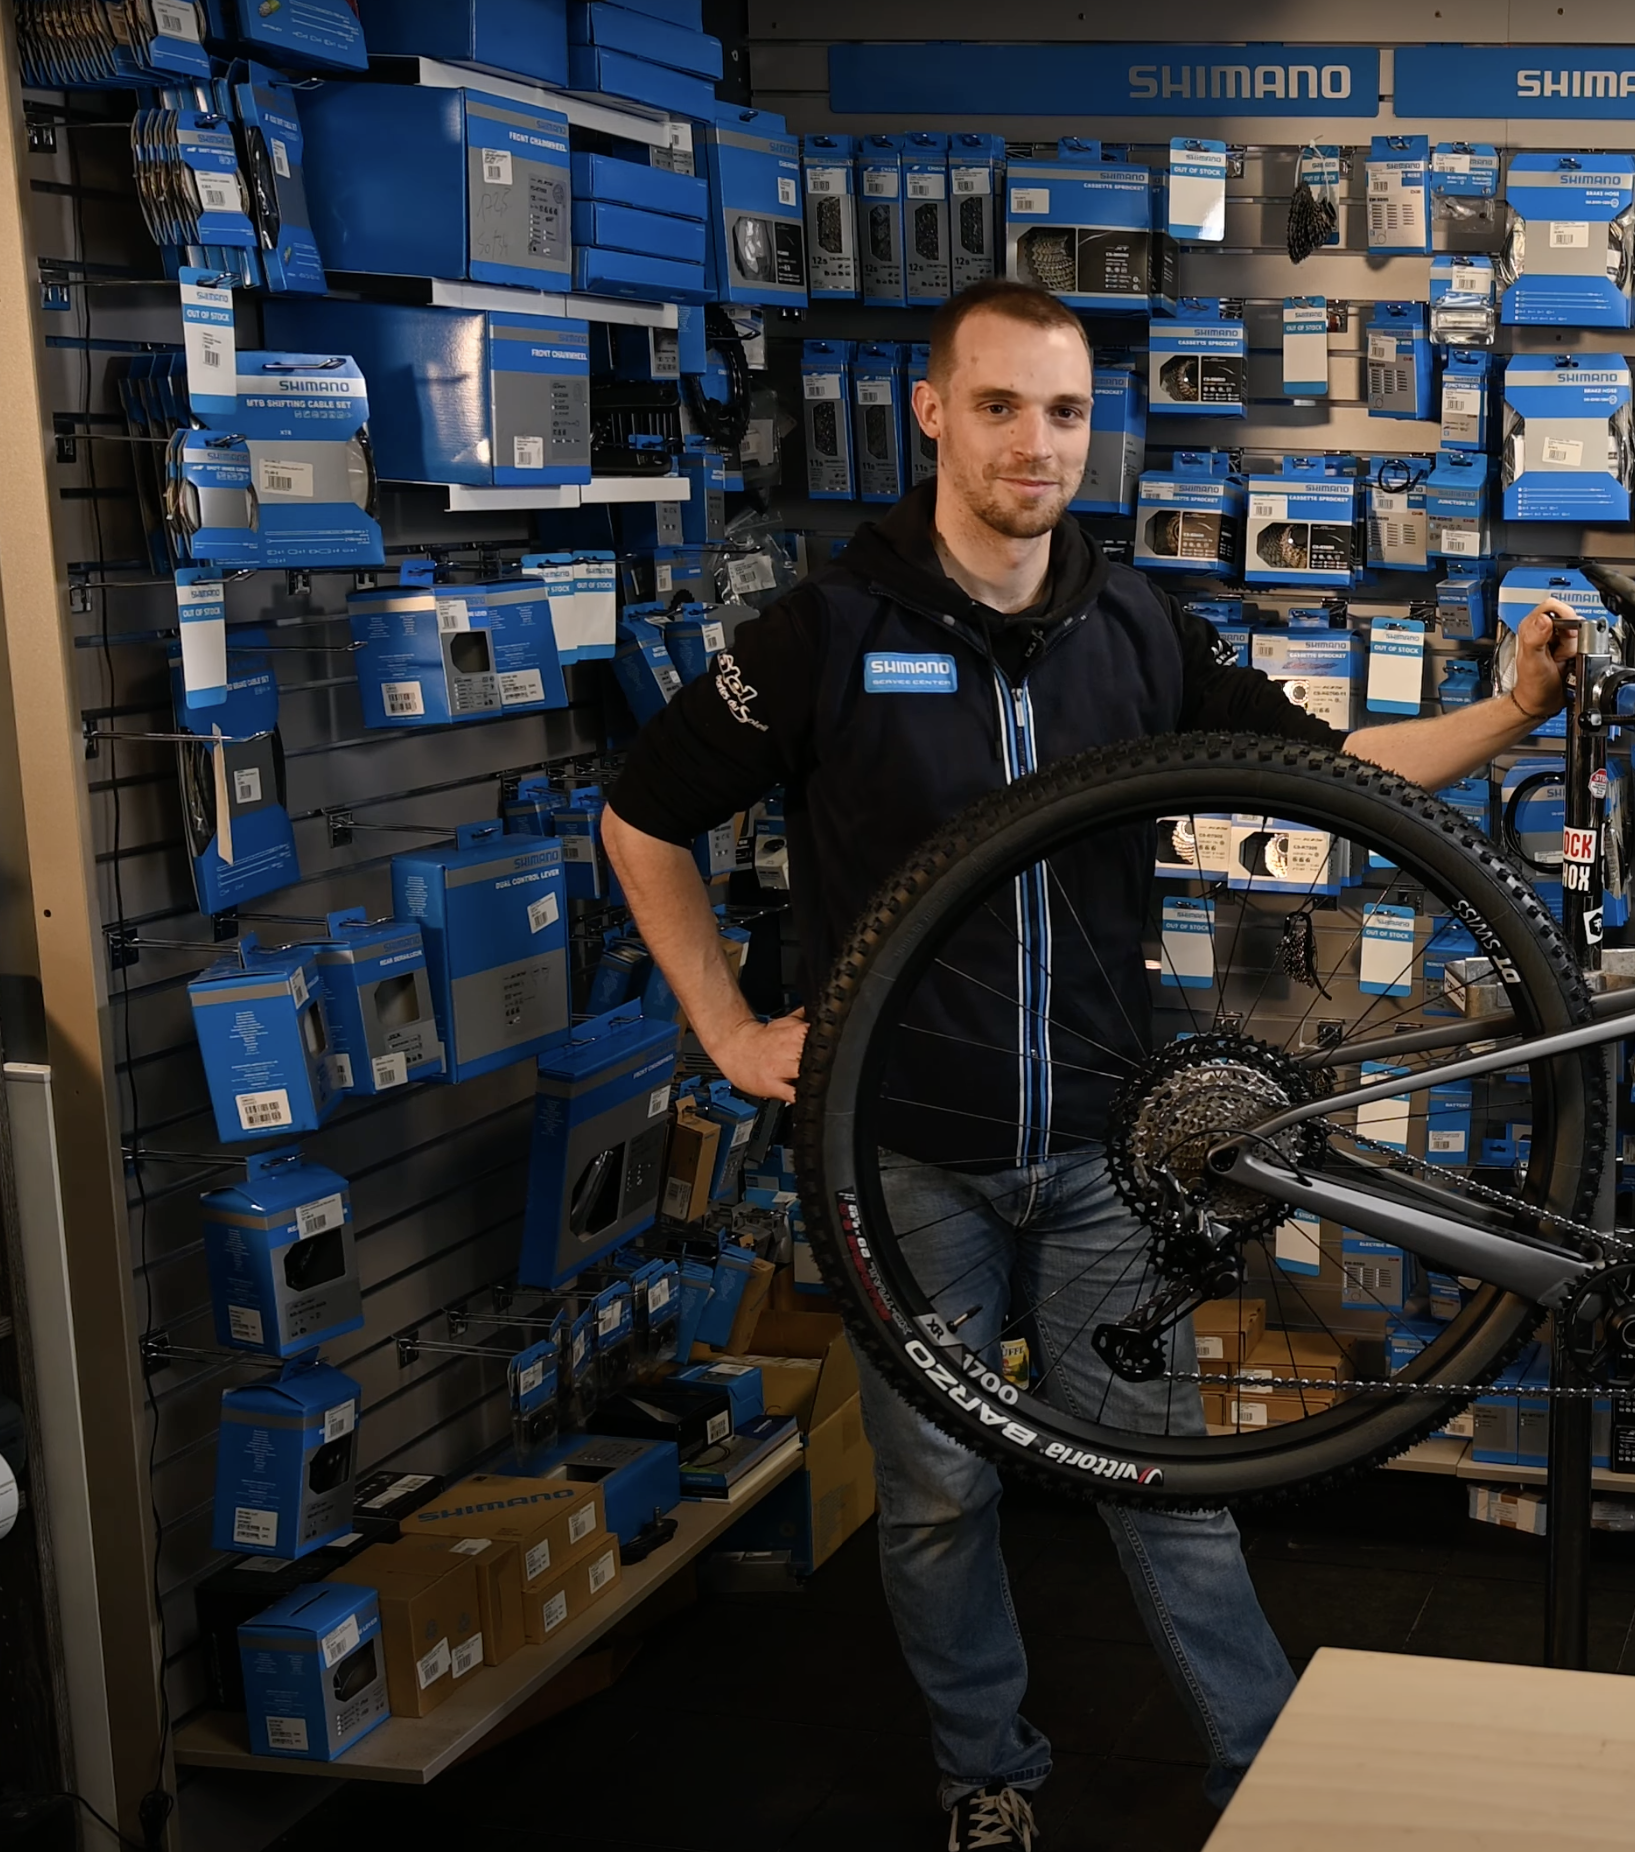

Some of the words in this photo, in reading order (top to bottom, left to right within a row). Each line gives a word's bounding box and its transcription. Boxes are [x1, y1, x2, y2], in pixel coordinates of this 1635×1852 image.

[1128, 65, 1351, 99] SHIMANO
[1100, 172, 1145, 182] SHIMANO
[1199, 168, 1221, 176] STOCK
[1560, 175, 1621, 185] SHIMANO
[186, 309, 199, 320] OUT
[200, 310, 208, 321] OF
[208, 311, 230, 323] STOCK
[1194, 329, 1239, 337] SHIMANO
[1305, 324, 1323, 332] STOCK
[531, 348, 549, 359] FRONT
[1557, 373, 1618, 382] SHIMANO
[279, 379, 350, 393] SHIMANO
[246, 398, 265, 408] MTB
[266, 399, 306, 409] SHIFTING
[308, 400, 334, 410] CABLE
[335, 400, 352, 410] SET
[1178, 485, 1219, 493] SHIMANO
[1305, 484, 1349, 493] SHIMANO
[182, 608, 195, 619] OUT
[196, 607, 205, 617] OF
[205, 606, 222, 617] STOCK
[1374, 644, 1387, 652] OUT
[1399, 646, 1419, 655] STOCK
[870, 660, 950, 675] SHIMANO
[1563, 832, 1594, 859] OCK
[514, 849, 559, 870] SHIMANO
[495, 878, 512, 889] DUAL
[512, 873, 540, 886] CONTROL
[540, 868, 560, 881] LEVER
[1562, 866, 1590, 892] HOX
[1392, 931, 1410, 939] STOCK
[1450, 898, 1503, 962] SWISS
[379, 957, 393, 966] REAR
[925, 1318, 946, 1340] XR
[961, 1352, 1019, 1406] 1700
[904, 1339, 1039, 1448] BARZO
[417, 1486, 575, 1524] SHIMANO
